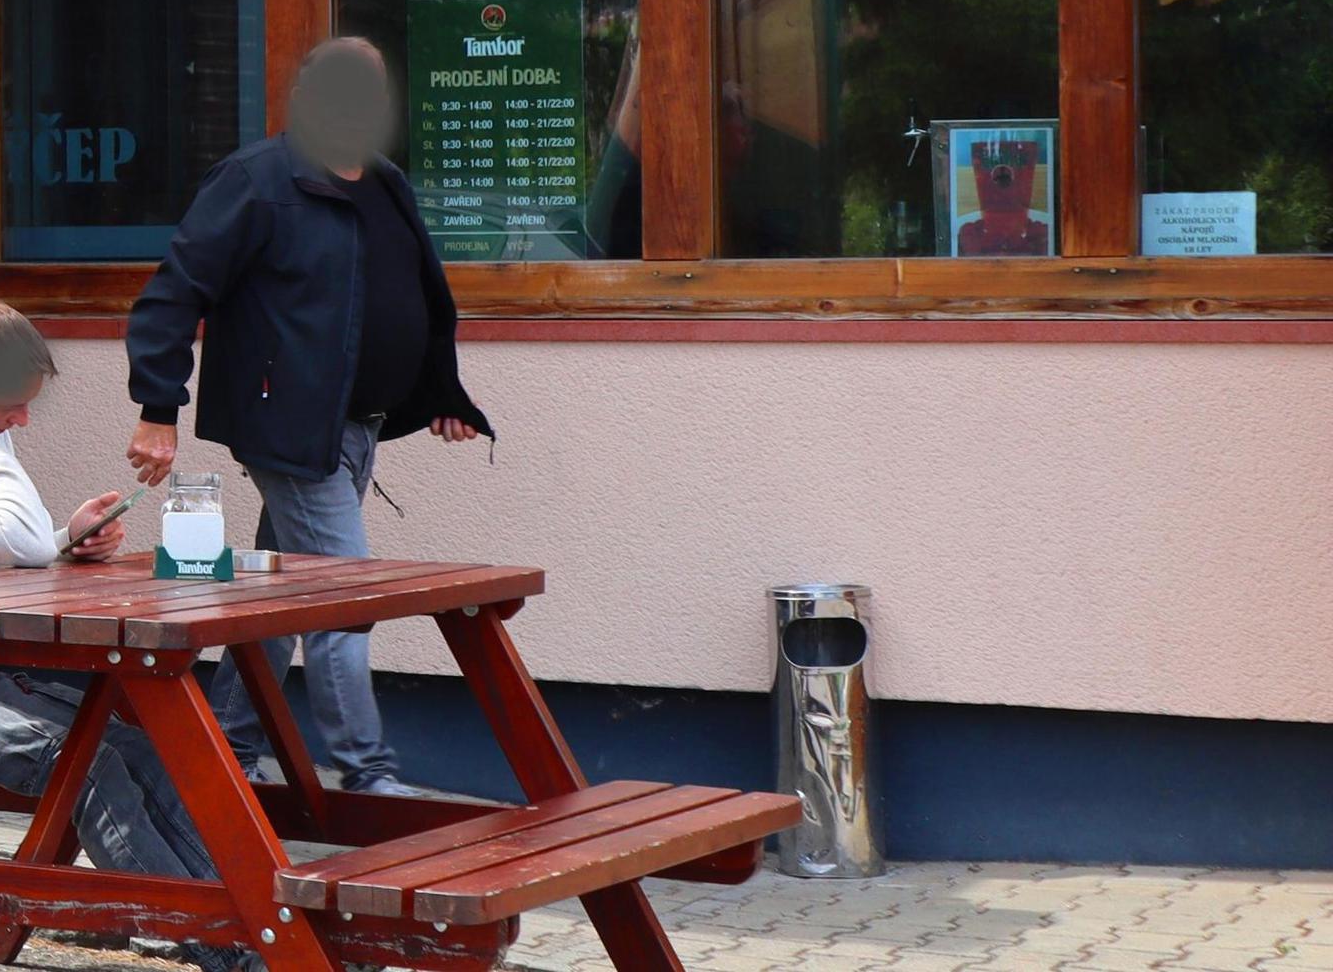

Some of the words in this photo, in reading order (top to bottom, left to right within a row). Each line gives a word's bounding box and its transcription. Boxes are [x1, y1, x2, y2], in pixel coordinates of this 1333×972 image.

[463, 35, 525, 57] Tambor
[431, 66, 508, 88] PRODEJNÍ
[512, 68, 561, 86] DOBA:
[442, 101, 461, 111] 9:30
[469, 100, 493, 110] 14:00
[505, 99, 528, 109] 14:00
[537, 98, 574, 108] 21/22:00
[442, 120, 461, 130] 9:30
[470, 120, 493, 130] 14:00
[505, 118, 528, 128] 14:00
[537, 118, 575, 127] 21/22:00
[442, 139, 461, 149] 9:30
[470, 138, 493, 148] 14:00
[506, 138, 529, 148] 14:00
[537, 137, 575, 147] 21/22:00
[442, 159, 461, 168] 9:30
[470, 158, 493, 168] 14:00
[506, 157, 529, 167] 14:00
[538, 156, 575, 166] 21/22:00
[443, 178, 462, 187] 9:30
[470, 177, 494, 187] 14:00
[506, 177, 529, 186] 14:00
[538, 176, 575, 186] 21/22:00
[444, 196, 482, 206] ZAVŘENO
[506, 196, 529, 206] 14:00
[538, 195, 576, 205] 21/22:00
[444, 215, 483, 226] ZAVŘENO
[507, 214, 545, 225] ZAVŘENO
[444, 241, 490, 252] PRODEJNA
[176, 561, 215, 575] Tambor
